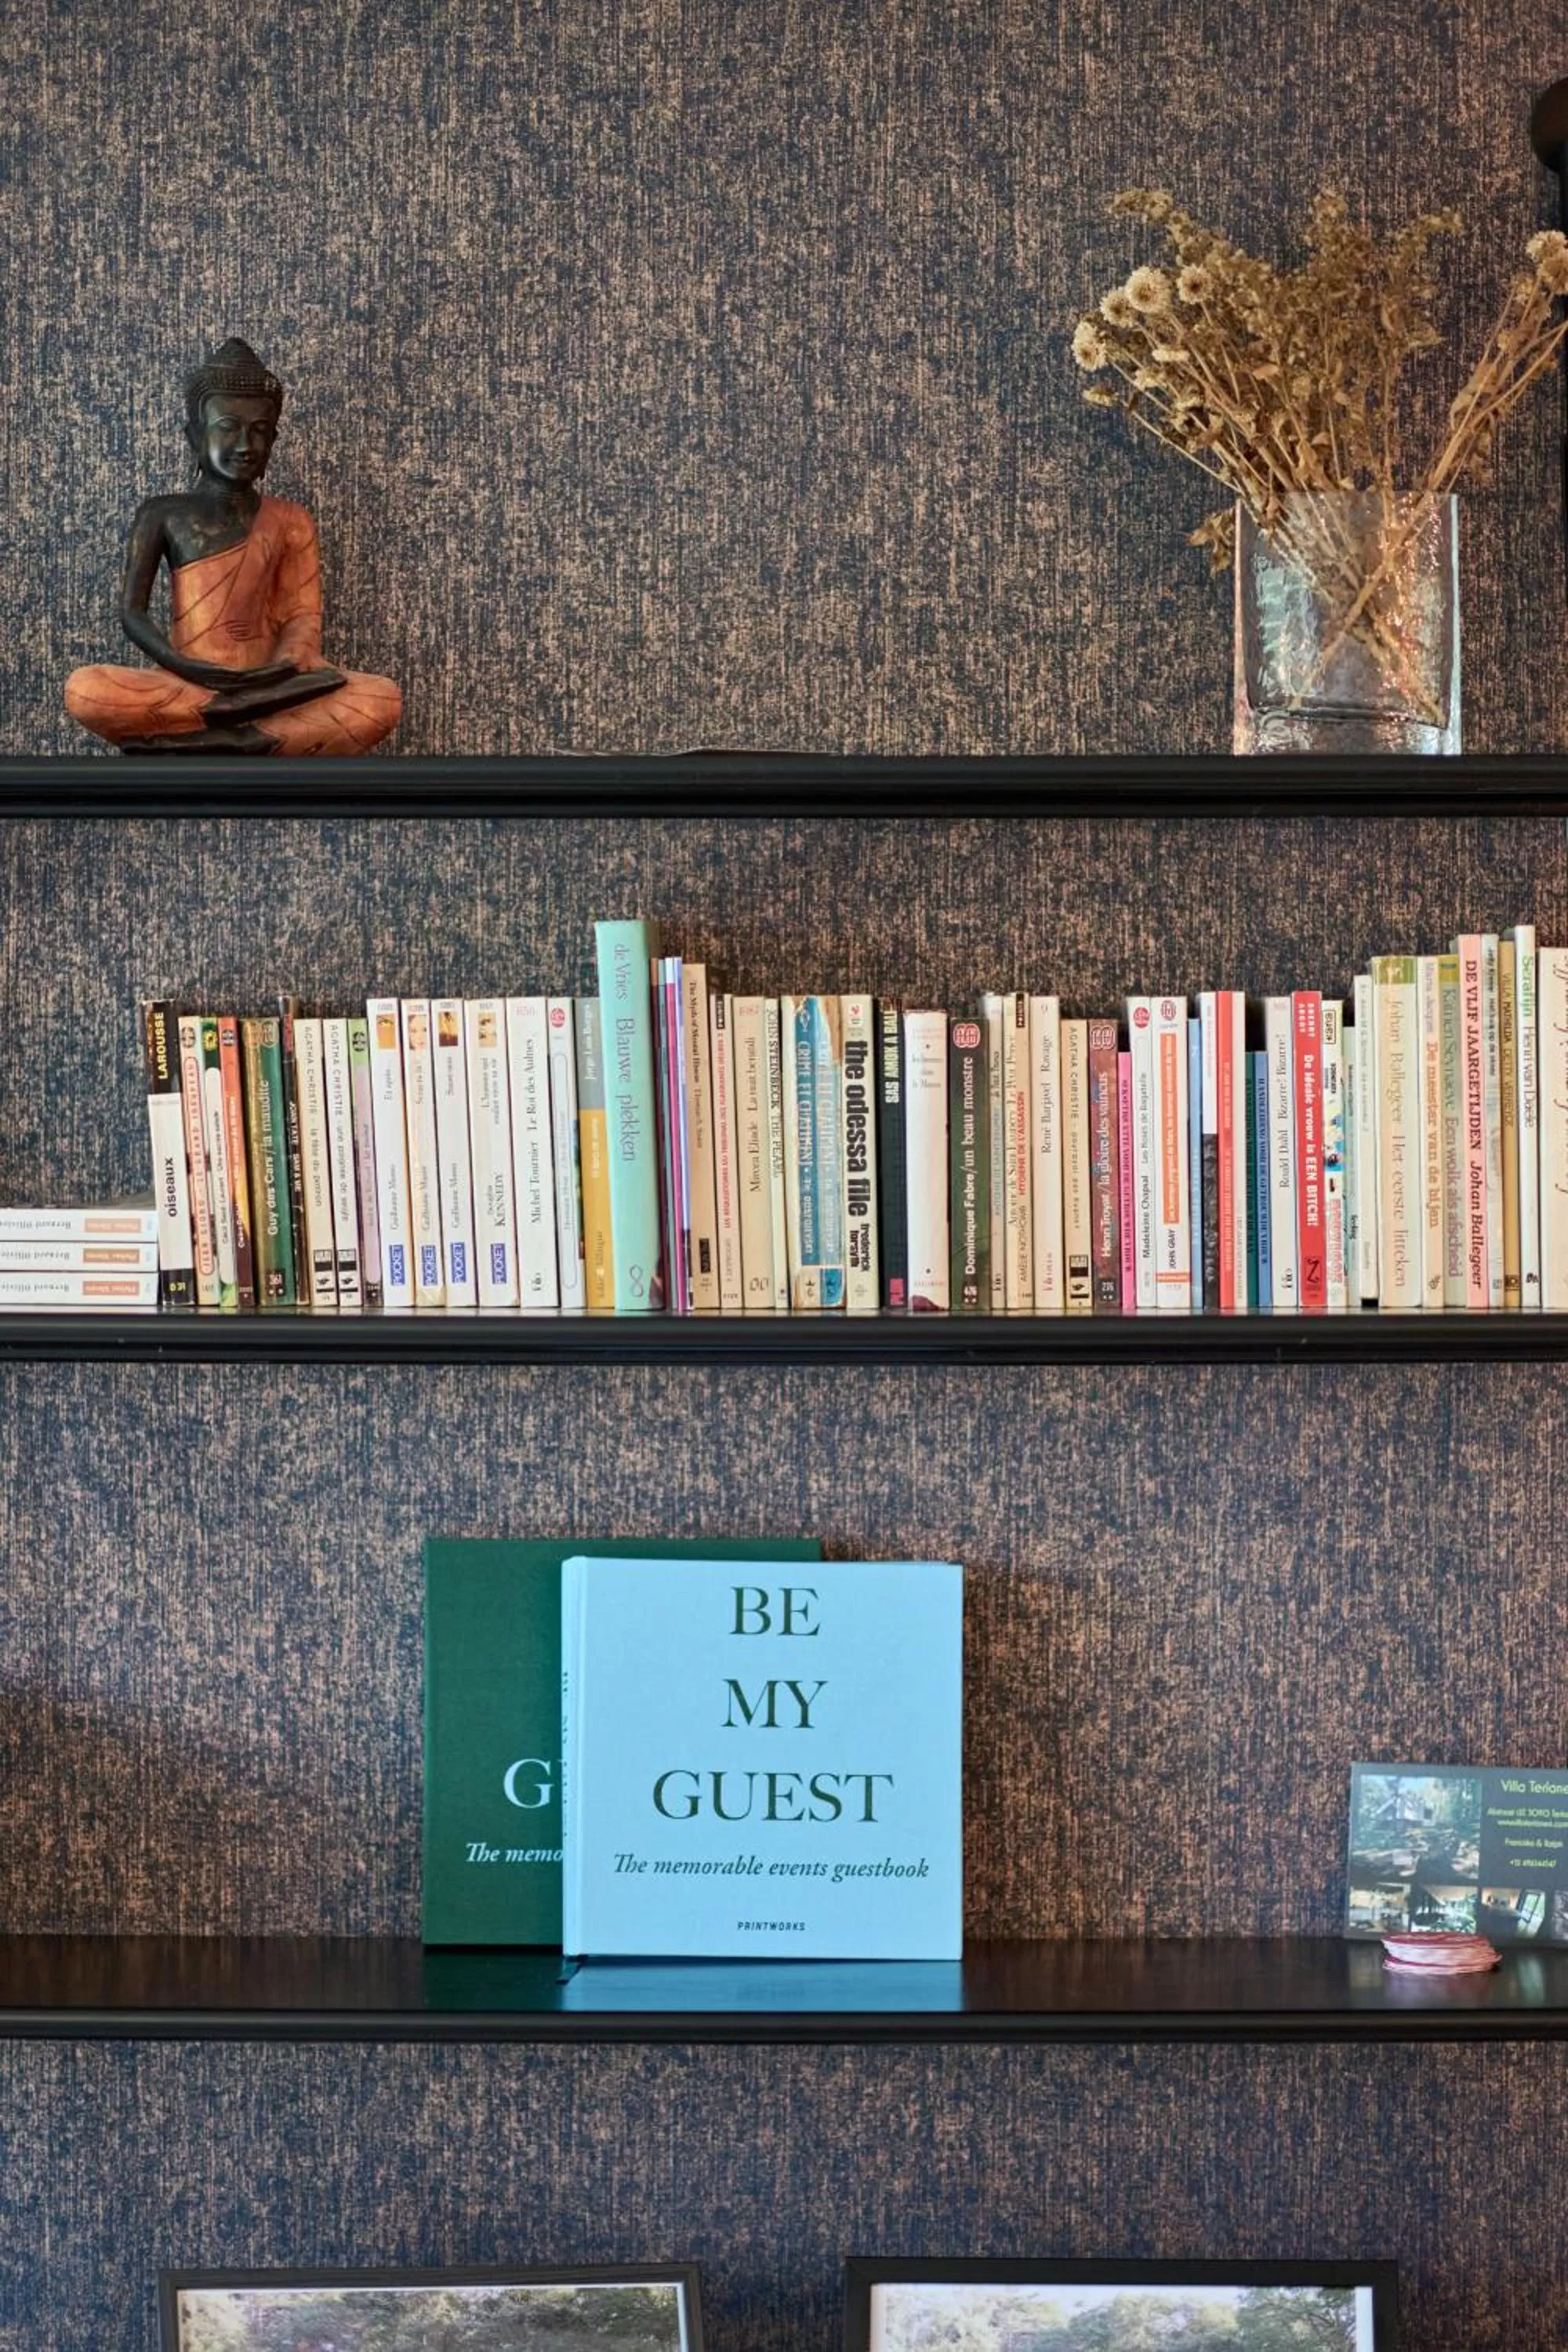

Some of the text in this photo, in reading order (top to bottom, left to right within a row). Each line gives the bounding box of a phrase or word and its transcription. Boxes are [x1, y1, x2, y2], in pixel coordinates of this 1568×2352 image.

[1503, 972, 1512, 999] VILLA
[884, 1011, 897, 1034] BALI
[1503, 1001, 1512, 1044] MATHILDA
[1520, 955, 1537, 1128] Serafijn Henri van Daele
[154, 1012, 169, 1080] LAROUSSE
[304, 1026, 314, 1064] AGATHA
[332, 1025, 341, 1065] AGATHA
[614, 943, 640, 1162] de Vries Blauwe plekken
[797, 1041, 811, 1076] CRIME
[884, 1047, 898, 1078] AMOK
[307, 1069, 317, 1113] CHRISTIE
[333, 1069, 343, 1117] CHRISTIE
[767, 1008, 783, 1178] JOHN STEINBECK THE PEARL
[797, 1083, 811, 1095] ET
[884, 1081, 899, 1103] SAS
[961, 1057, 974, 1110] monstre
[1069, 1027, 1079, 1119] AGATHA CHRISTIE
[1096, 1072, 1109, 1115] vaincus
[259, 1079, 271, 1131] maudite
[1040, 1035, 1054, 1154] René Barjavel Ravage
[523, 1039, 542, 1225] Michel Tournier Le Roi des Aulnes
[844, 1041, 871, 1217] the odessa file
[961, 1114, 974, 1145] beau
[1097, 1117, 1109, 1137] des
[1277, 1130, 1289, 1155] Dahl
[1304, 1054, 1318, 1227] De ideale vrouw is EEN BITCH!
[1386, 1000, 1409, 1287] Johan Ballegeer Het eerste litteken
[1426, 1041, 1440, 1229] De meester van de bijen
[1445, 1116, 1458, 1145] Een
[1465, 960, 1484, 1290] DE VIJF JAARGETIJDEN Johan Ballegeer
[1017, 1145, 1025, 1155] DE
[1097, 1137, 1112, 1172] gloire
[1446, 1149, 1461, 1185] wolk
[164, 1157, 177, 1218] oiseaux
[748, 1156, 761, 1192] Mircea
[1141, 1175, 1152, 1210] Chapsal
[1279, 1158, 1290, 1188] Roald
[267, 1188, 276, 1208] des
[494, 1173, 506, 1227] KENNEDY
[1447, 1188, 1462, 1211] als
[267, 1212, 280, 1236] Guy
[964, 1210, 978, 1275] Dominique
[1101, 1228, 1111, 1258] Henri
[1142, 1212, 1151, 1258] Madeleine
[390, 1245, 403, 1286] POCKET
[423, 1245, 436, 1286] POCKET
[452, 1242, 464, 1283] POCKET
[493, 1243, 505, 1283] POCKET
[849, 1230, 861, 1267] forsyth
[860, 1223, 871, 1272] frederick
[1167, 1229, 1177, 1269] JOHN GRAY
[1448, 1213, 1464, 1278] afscheid
[729, 1586, 821, 1637] BE
[720, 1679, 829, 1730] MY
[503, 1759, 562, 1809] G
[652, 1769, 895, 1823] GUEST
[1501, 1780, 1526, 1793] Villa
[466, 1842, 500, 1862] The
[614, 1853, 930, 1882] The memorable events guestbook
[737, 1922, 806, 1931] PRINTWORKS
